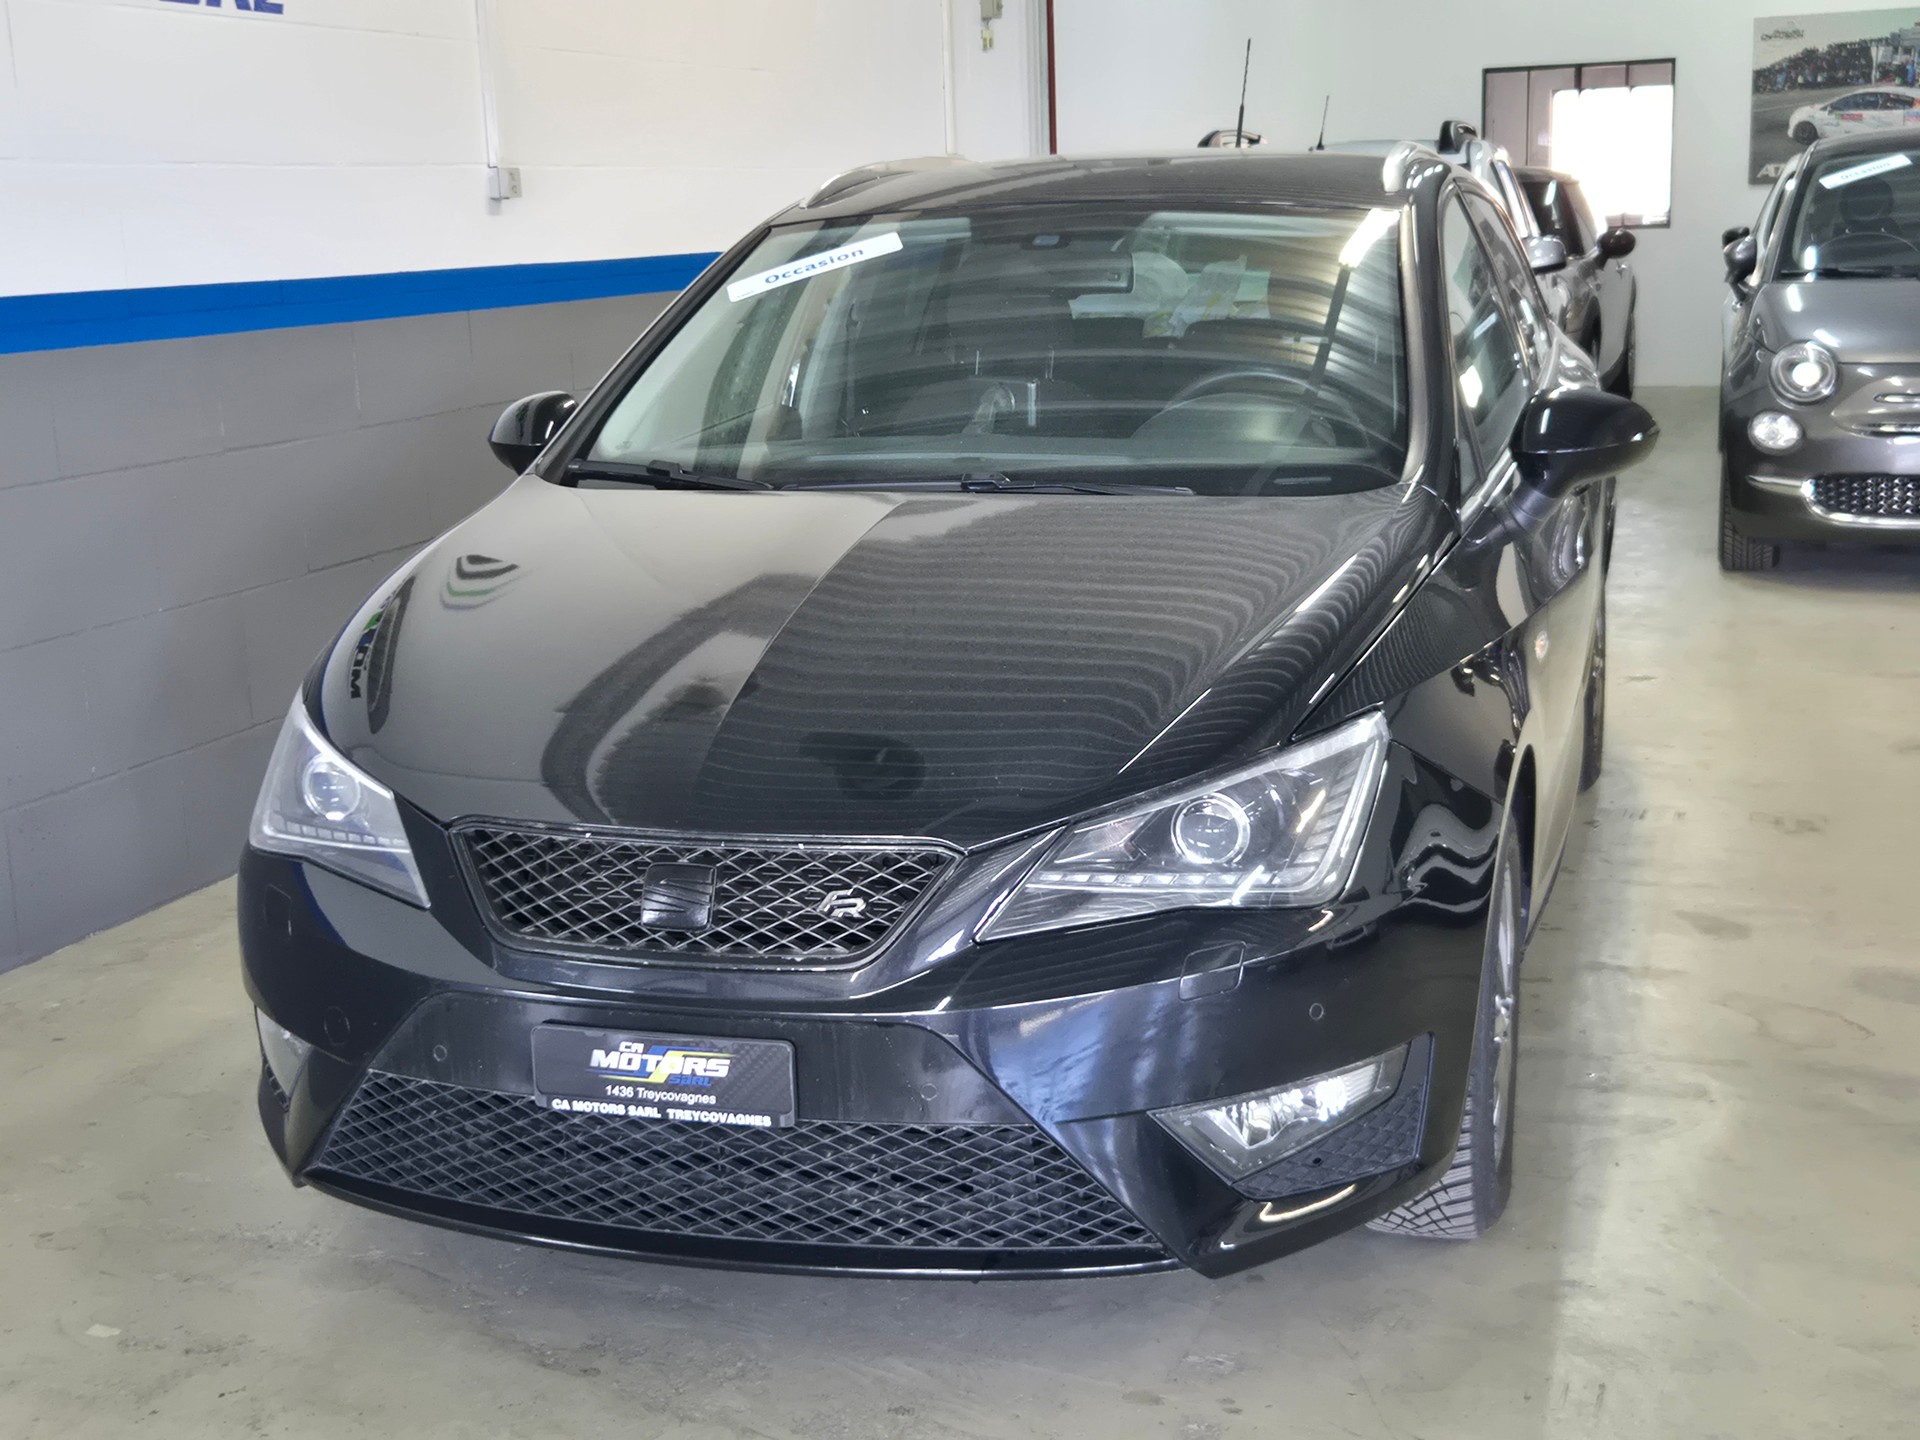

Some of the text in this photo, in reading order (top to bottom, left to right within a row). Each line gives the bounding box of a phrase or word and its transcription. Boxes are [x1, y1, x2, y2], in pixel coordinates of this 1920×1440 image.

[764, 248, 864, 284] Occasion
[618, 1041, 644, 1053] CA
[590, 1049, 731, 1077] MOTORS
[605, 1085, 717, 1105] 1436 Treycovagnes
[552, 1098, 772, 1127] CA MOTORS SARL TREYCOVAGNES
